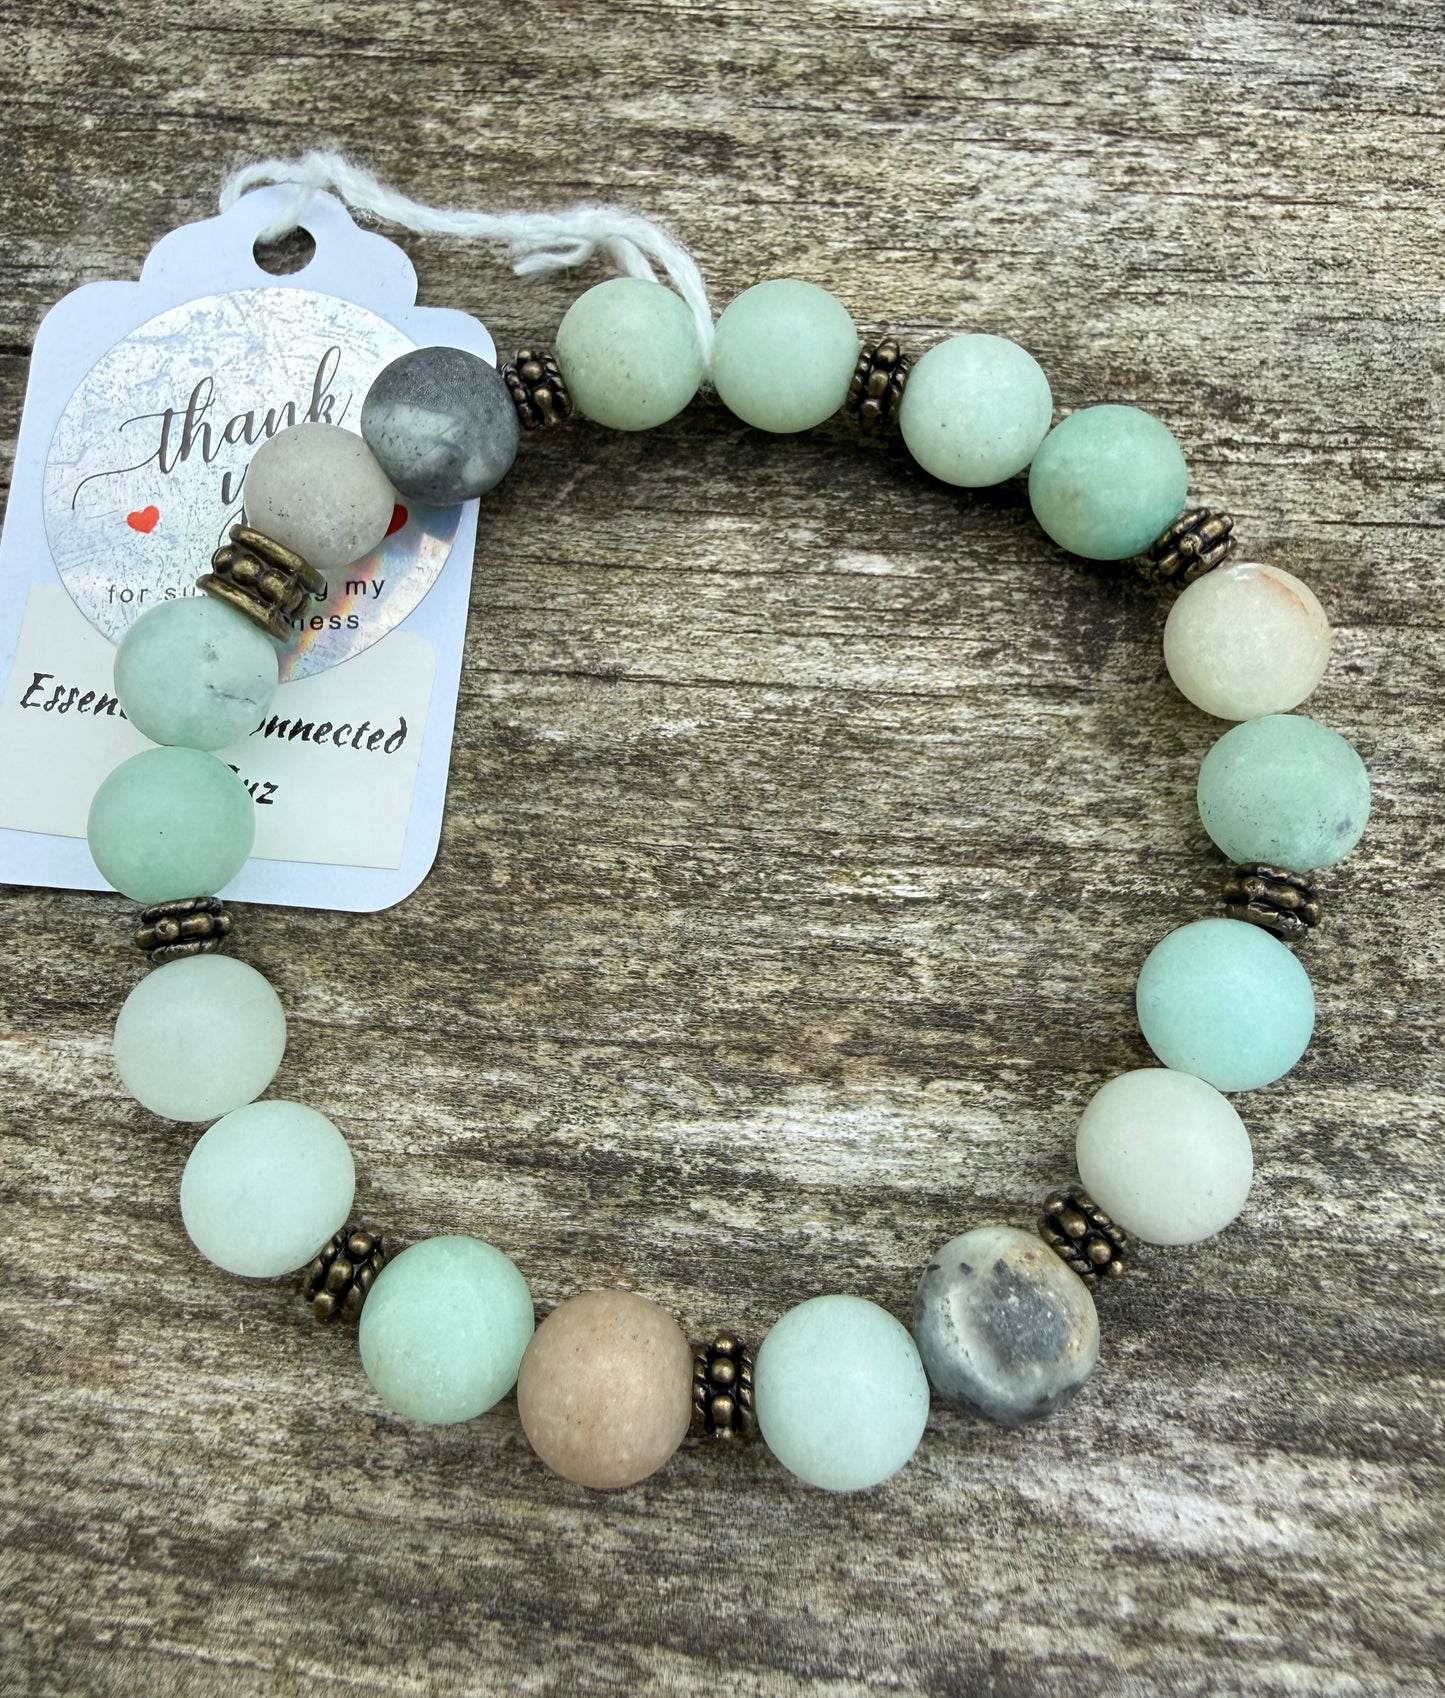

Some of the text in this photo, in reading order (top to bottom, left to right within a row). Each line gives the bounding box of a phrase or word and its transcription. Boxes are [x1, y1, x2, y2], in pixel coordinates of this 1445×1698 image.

[72, 345, 354, 511] thank
[107, 584, 149, 604] for
[345, 579, 386, 600] my
[249, 715, 408, 754] nnected
